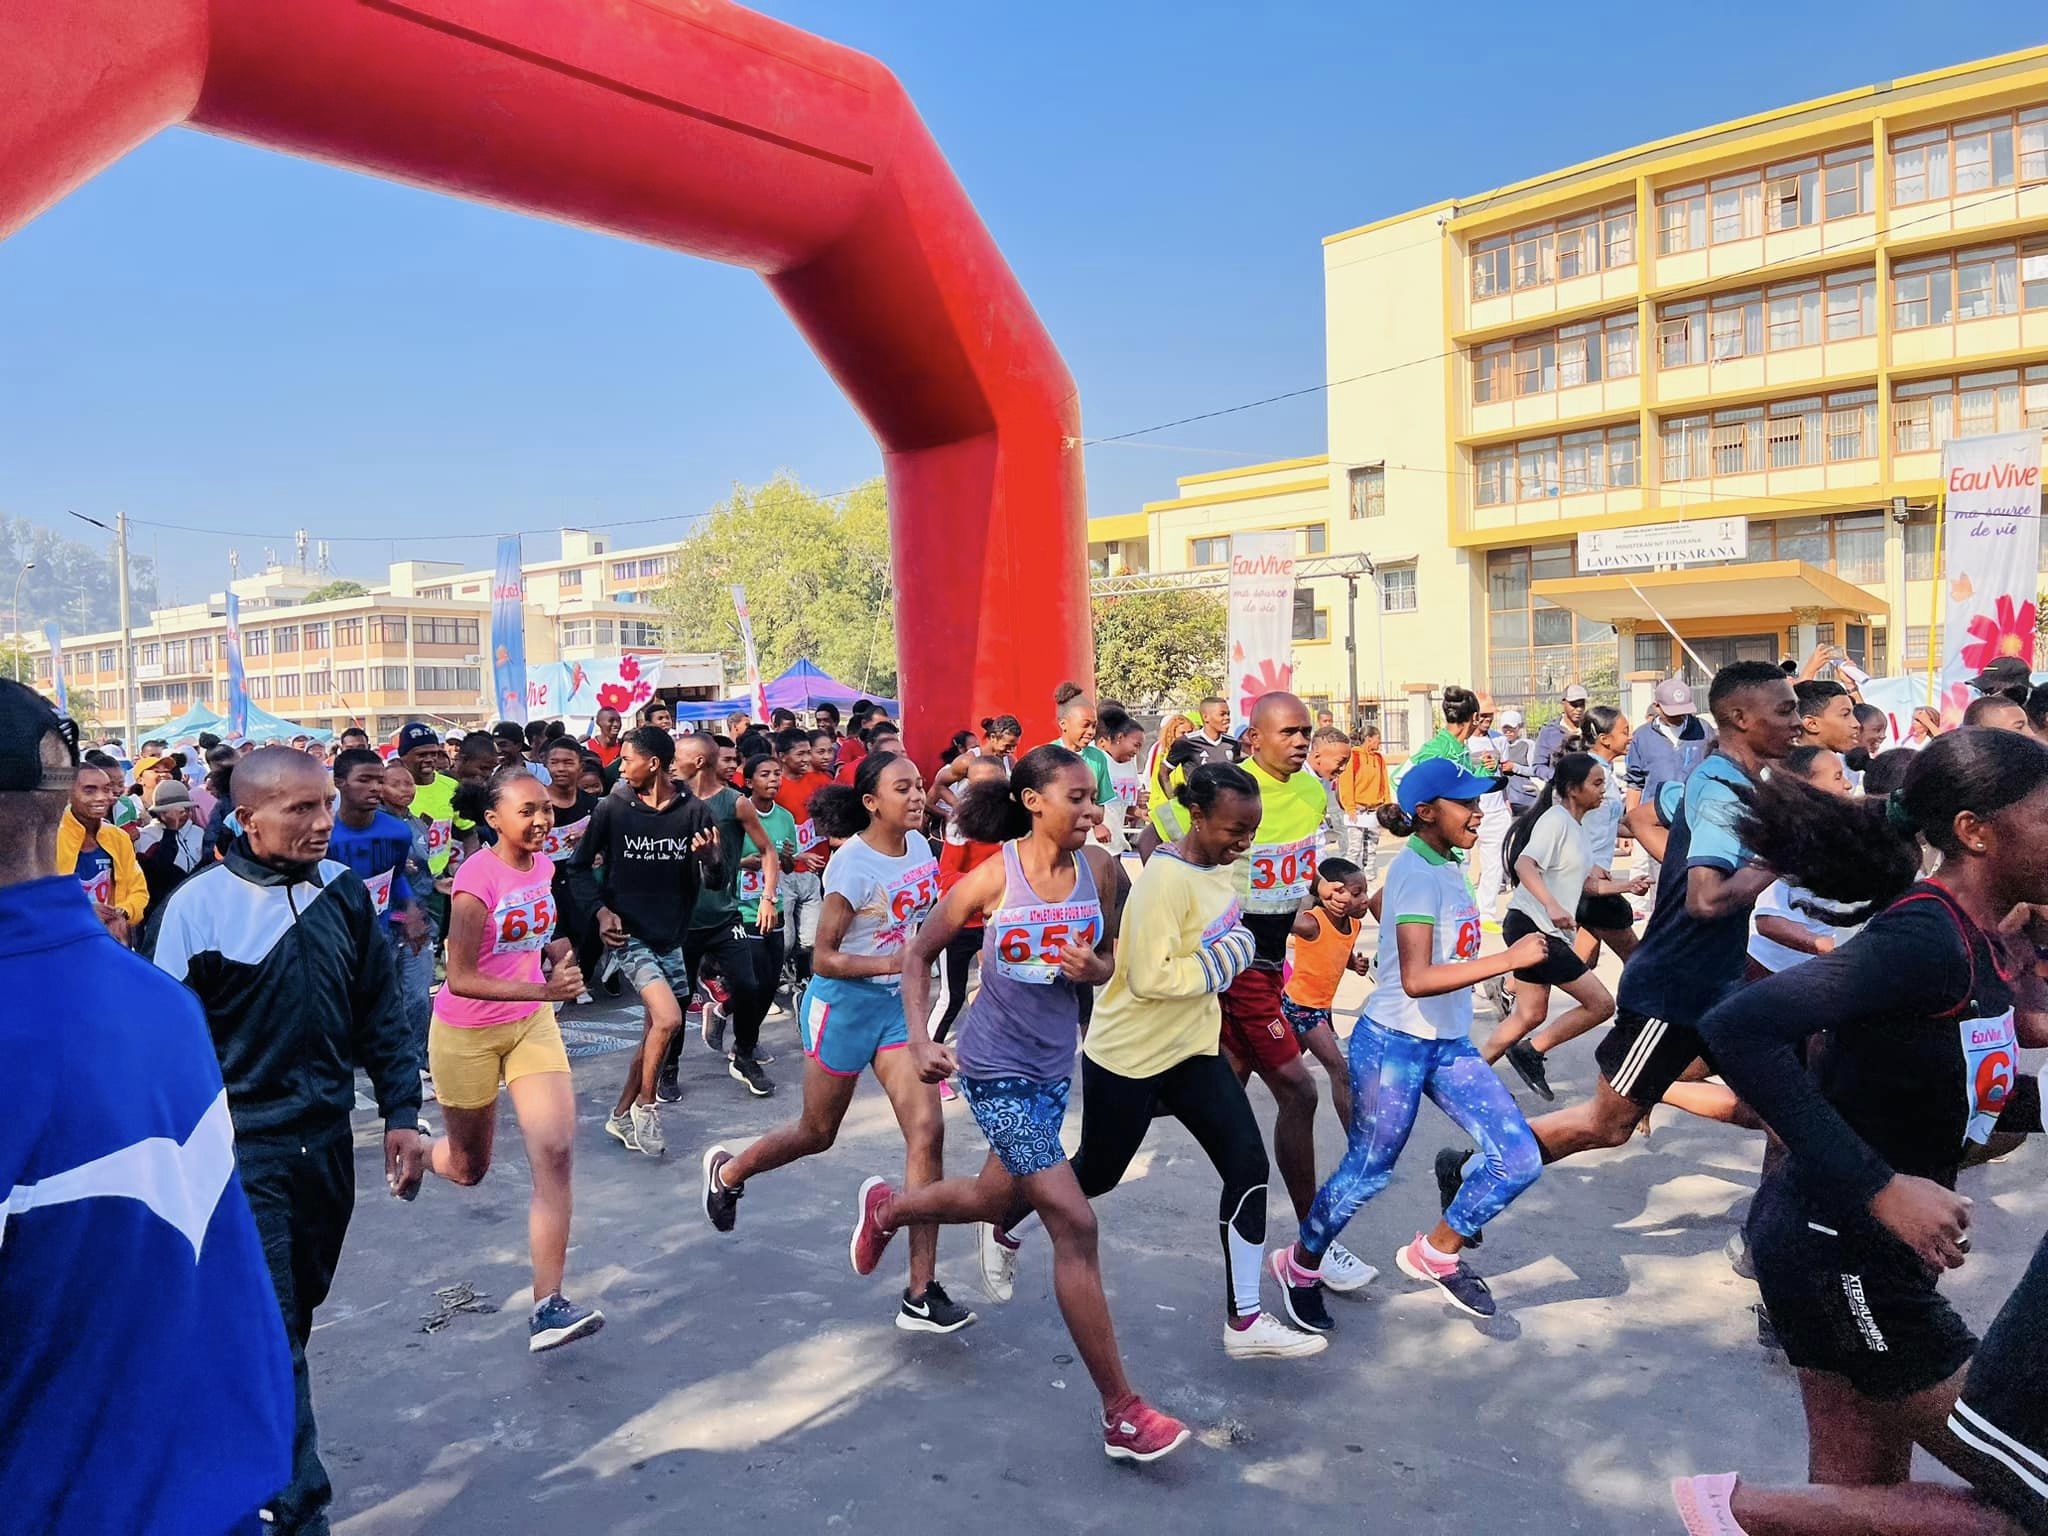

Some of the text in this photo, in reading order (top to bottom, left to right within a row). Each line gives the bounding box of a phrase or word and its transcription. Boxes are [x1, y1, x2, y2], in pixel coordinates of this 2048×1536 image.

[1971, 520, 2017, 537] de vie
[1656, 546, 1737, 562] FITSARANA
[624, 834, 688, 853] WAITING
[624, 850, 634, 858] For
[1253, 850, 1316, 890] 303
[502, 900, 559, 942] 65
